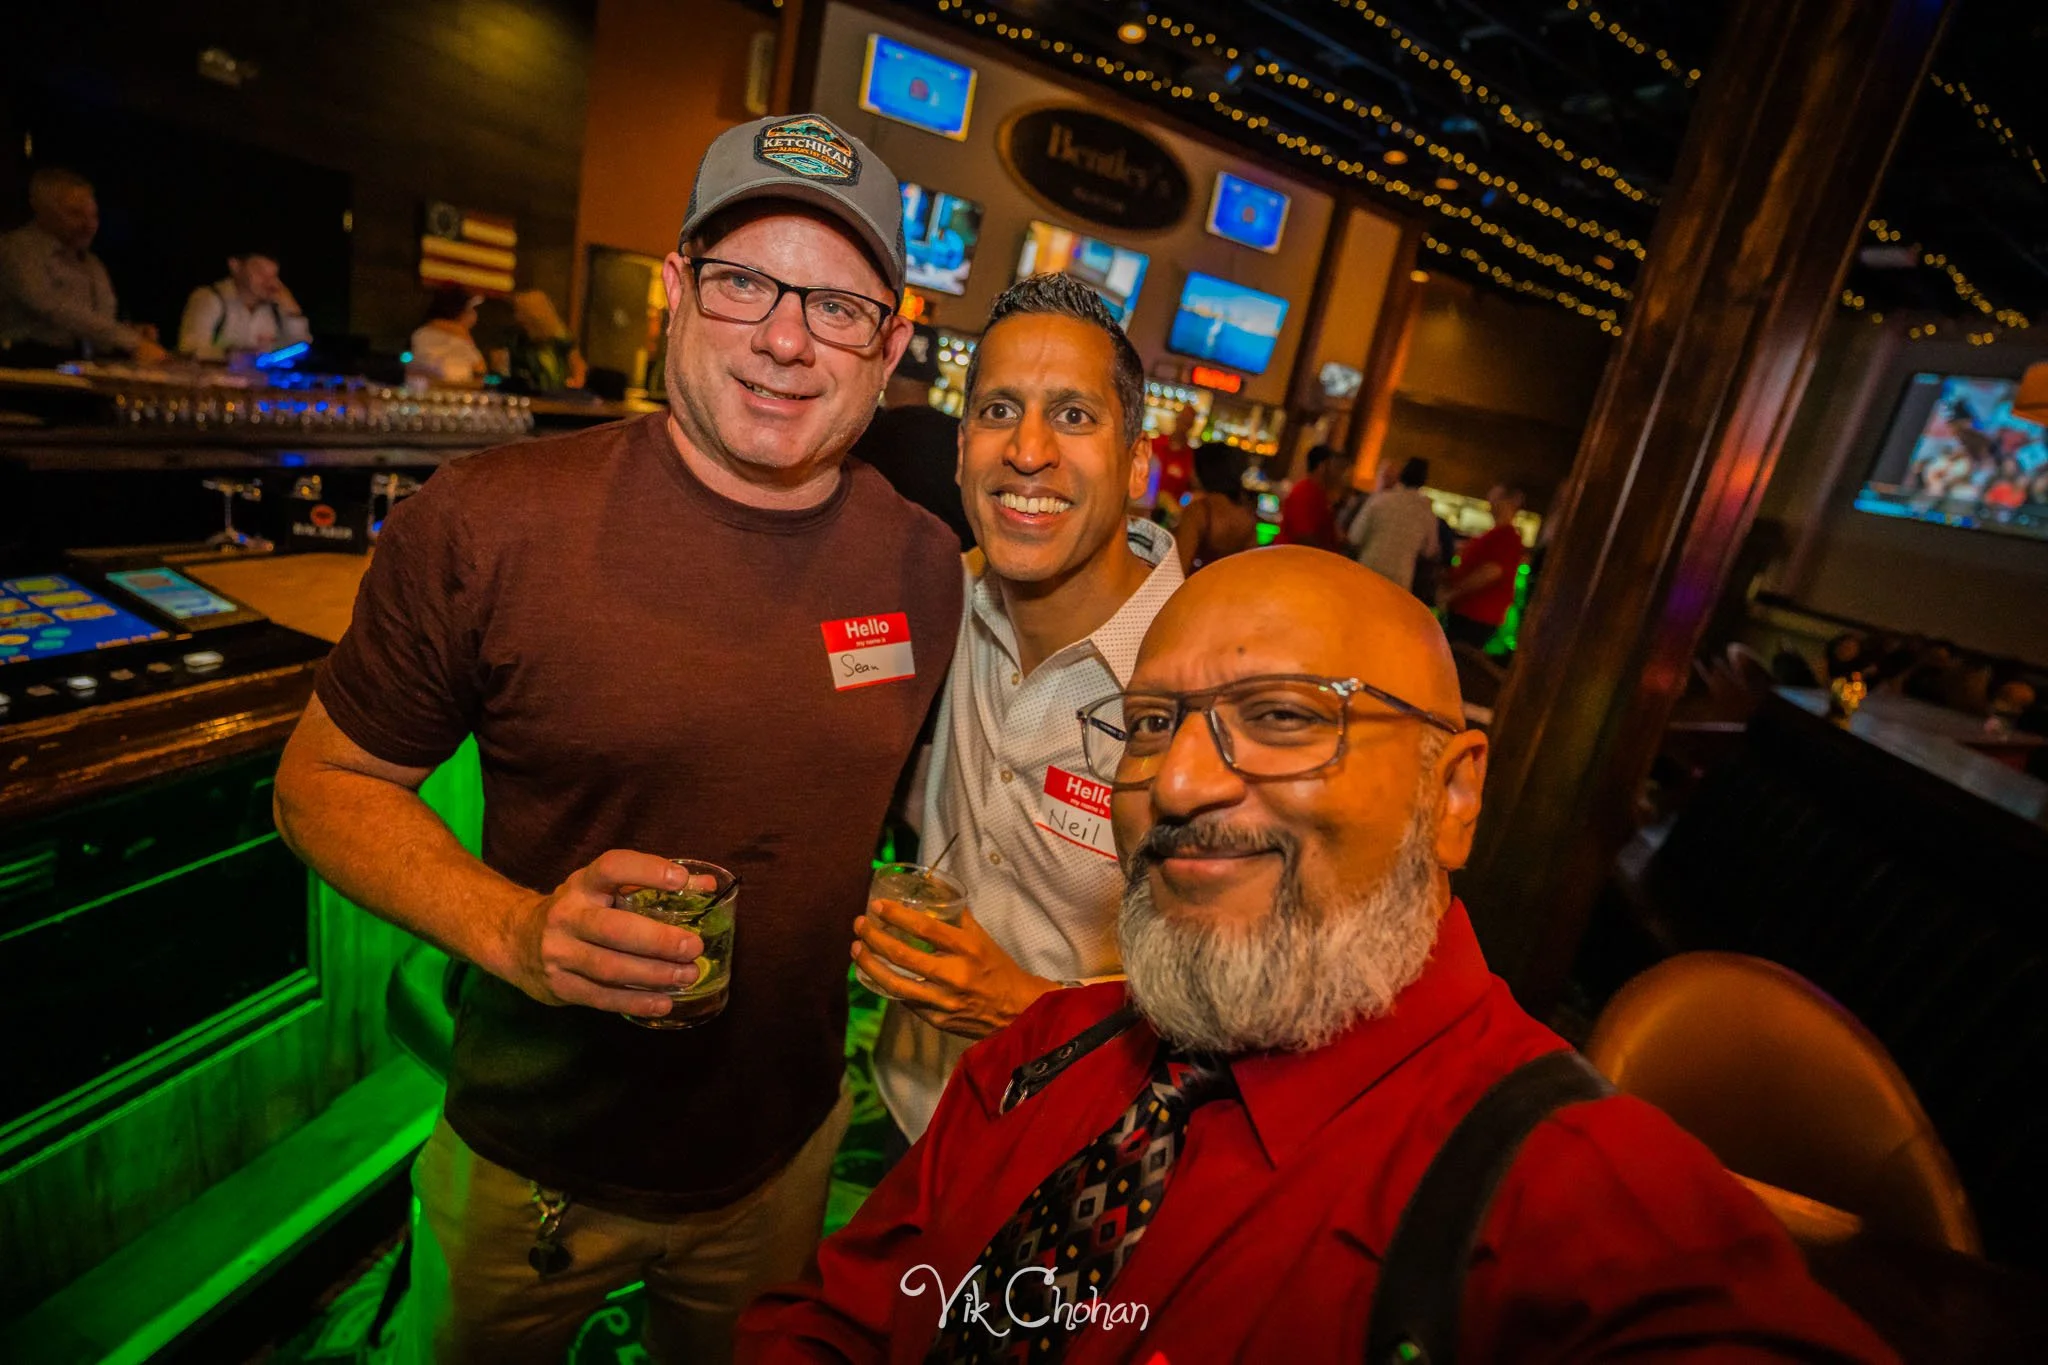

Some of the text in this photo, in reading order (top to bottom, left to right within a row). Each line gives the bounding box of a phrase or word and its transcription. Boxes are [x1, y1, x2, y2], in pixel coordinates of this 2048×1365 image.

[763, 138, 853, 168] KETCHIKAN
[844, 618, 890, 639] Hello
[841, 653, 880, 678] Sean
[1049, 808, 1100, 845] Neil
